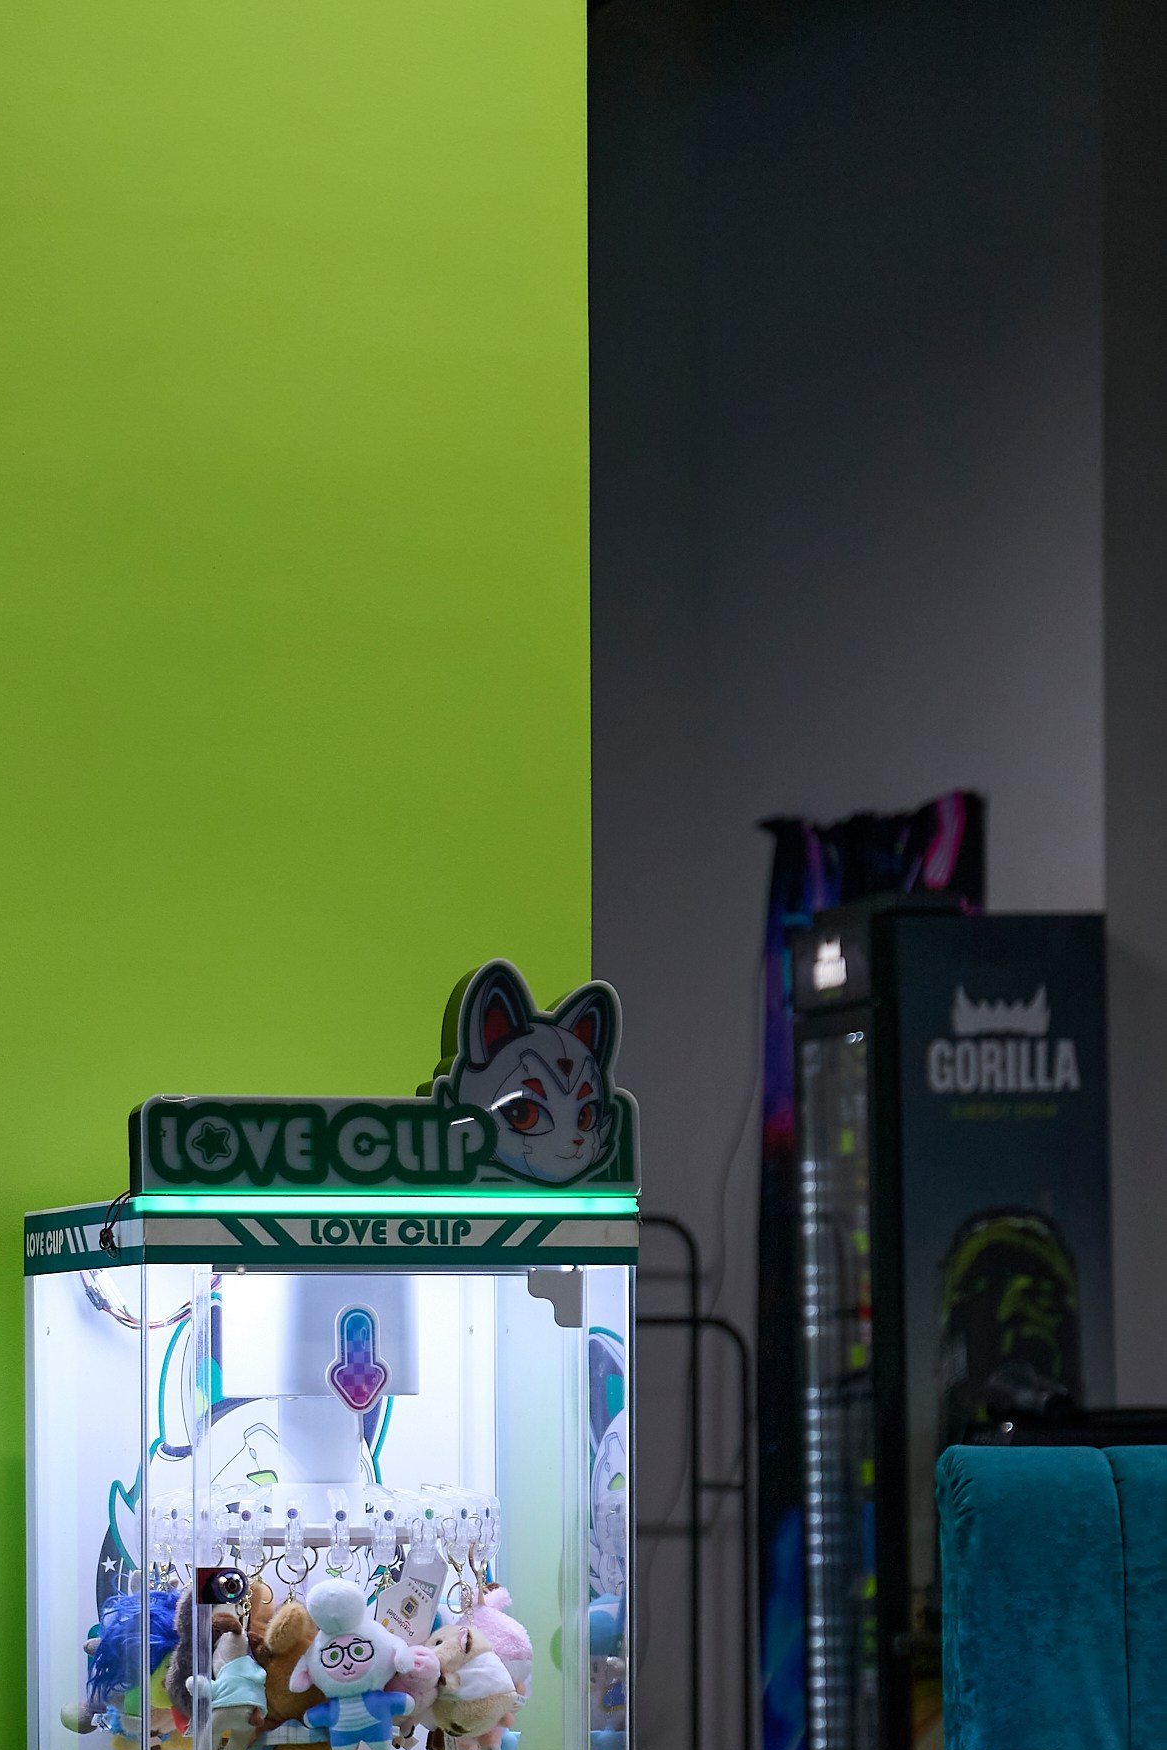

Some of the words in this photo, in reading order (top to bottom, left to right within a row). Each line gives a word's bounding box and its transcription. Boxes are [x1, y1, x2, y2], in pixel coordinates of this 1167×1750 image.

[927, 1038, 1081, 1092] GORILLA
[158, 1115, 315, 1172] LOVE
[338, 1114, 486, 1172] CLIP
[26, 1232, 44, 1257] LOVE
[46, 1229, 64, 1255] CLIP
[310, 1218, 387, 1246] LOVE
[398, 1218, 471, 1246] CLIP
